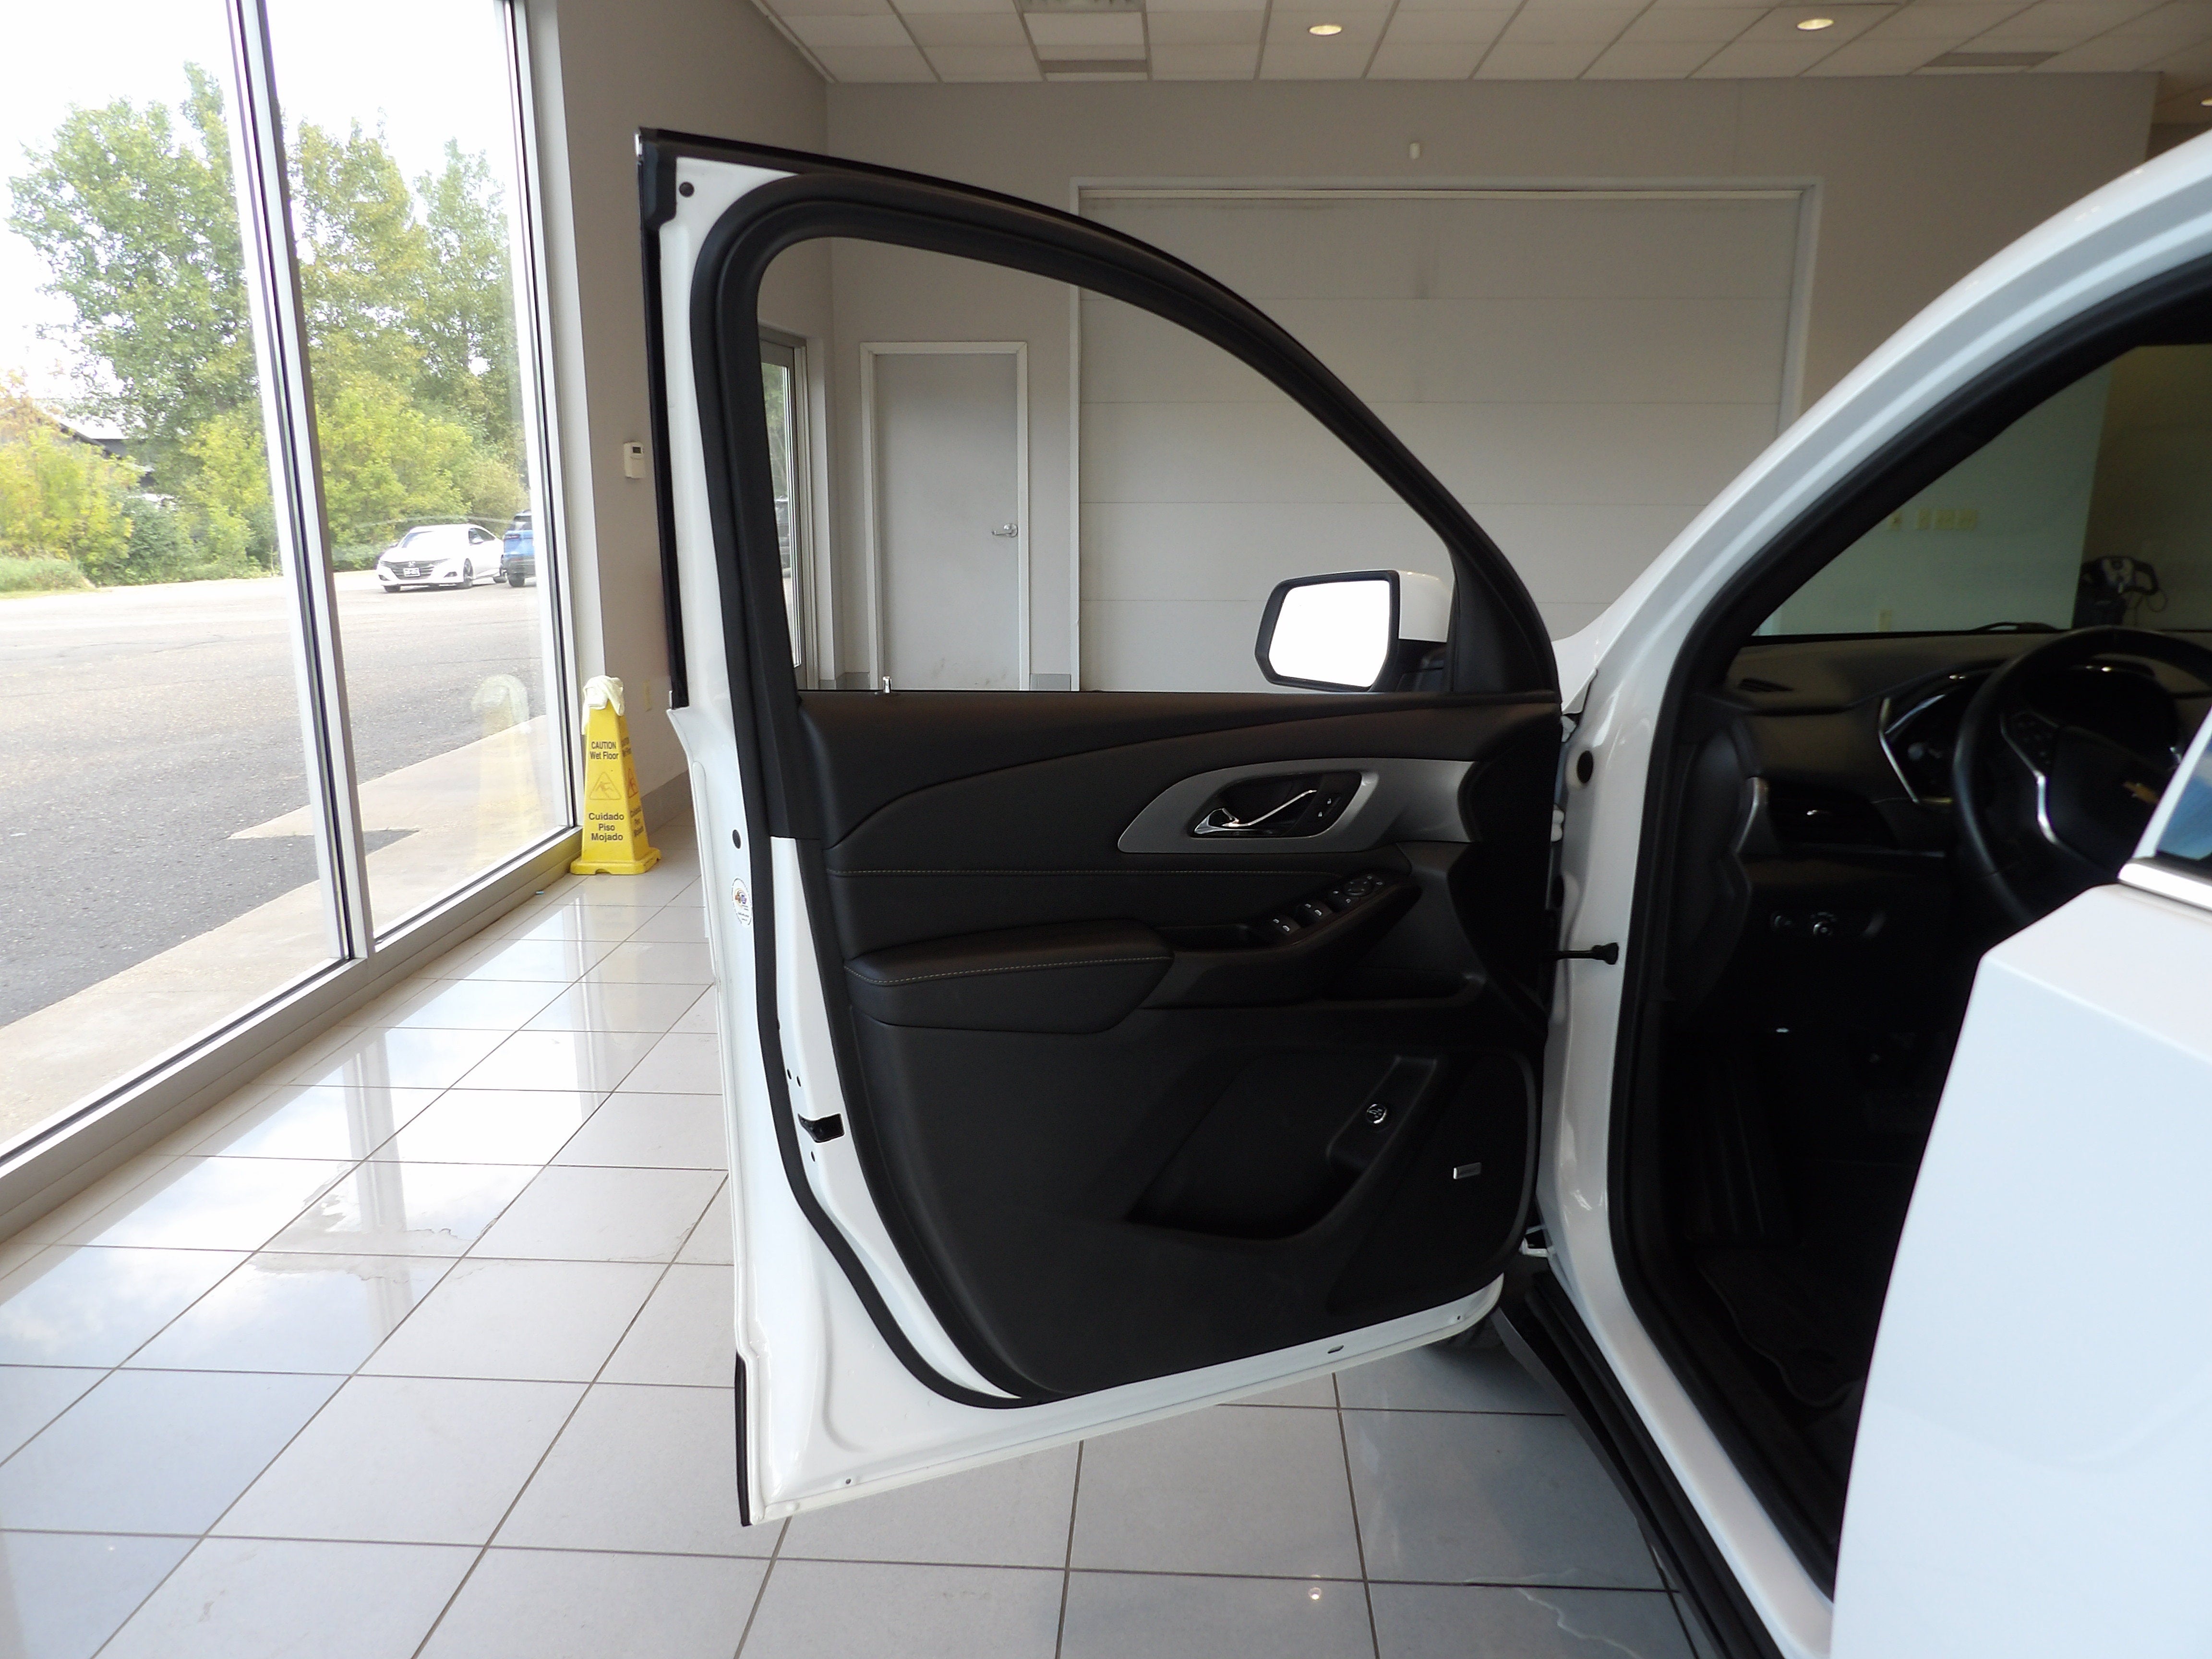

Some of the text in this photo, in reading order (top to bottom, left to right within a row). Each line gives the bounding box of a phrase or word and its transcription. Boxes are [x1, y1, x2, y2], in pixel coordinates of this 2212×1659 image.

[590, 751, 601, 759] Wet
[603, 751, 619, 759] Floor
[591, 833, 623, 842] Mojado
